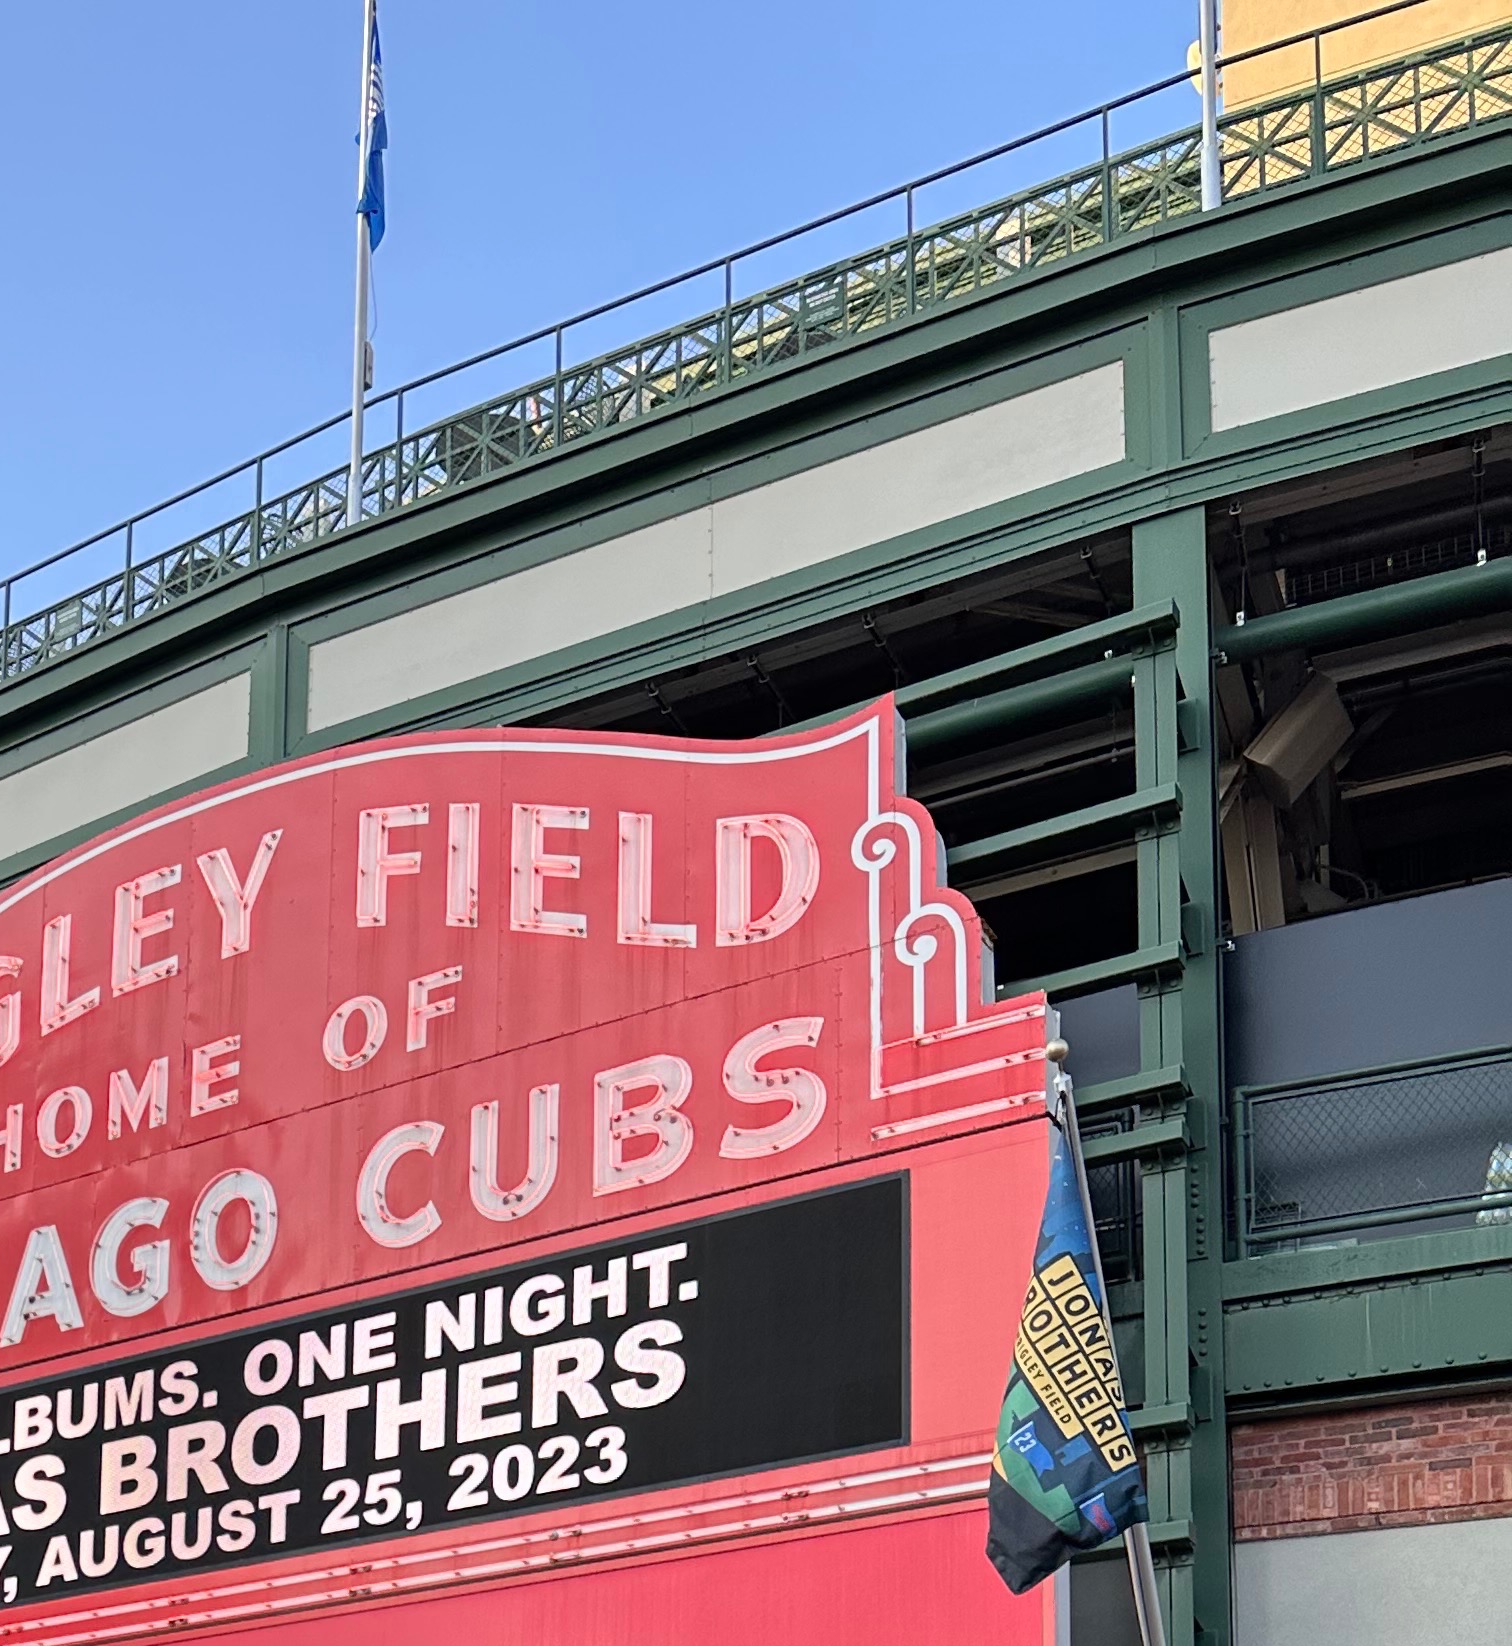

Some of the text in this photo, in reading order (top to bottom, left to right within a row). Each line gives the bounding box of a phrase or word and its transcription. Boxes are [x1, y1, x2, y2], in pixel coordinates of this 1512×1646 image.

[356, 802, 820, 948] FIELD
[322, 965, 463, 1071] OF
[356, 1016, 826, 1248] CUBS
[244, 1311, 397, 1396] ONE
[424, 1242, 699, 1360] NIGHT.
[99, 1318, 686, 1515] BROTHERS
[1014, 1431, 1036, 1453] 23
[1040, 1377, 1071, 1428] FIELD
[35, 1490, 301, 1588] AUGUST
[320, 1469, 423, 1535] 25,
[446, 1425, 628, 1512] 2023
